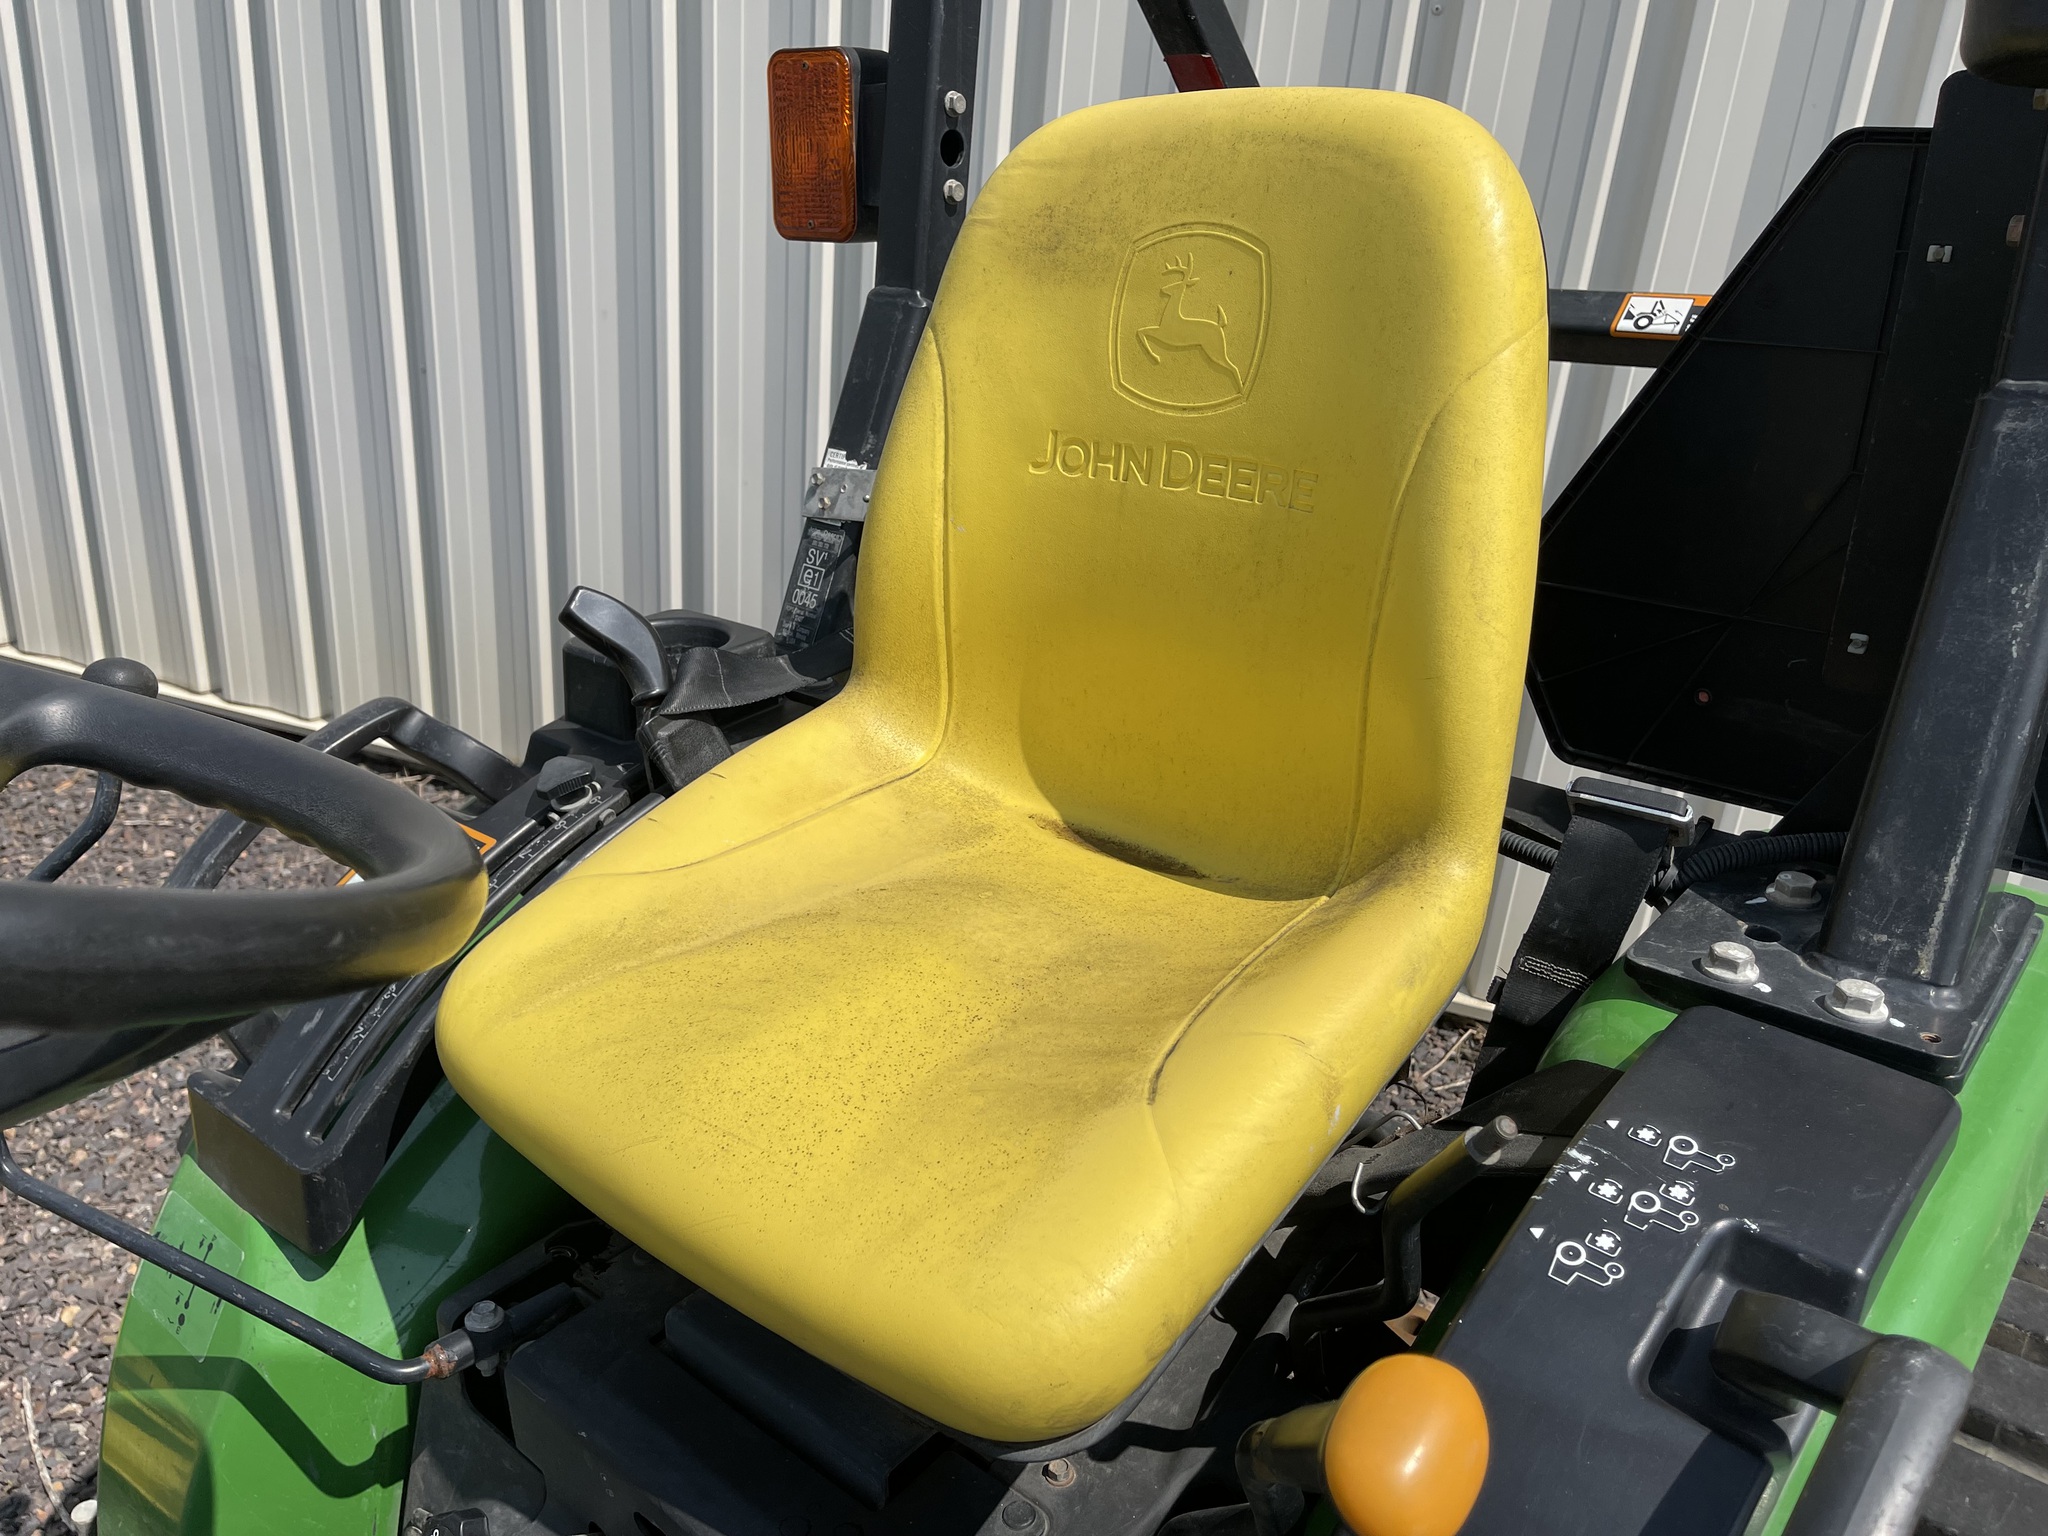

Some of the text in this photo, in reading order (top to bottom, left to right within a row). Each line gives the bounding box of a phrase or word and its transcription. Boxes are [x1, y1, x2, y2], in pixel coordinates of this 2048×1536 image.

[1028, 429, 1319, 514] JOHN DEERE
[792, 588, 818, 609] 0045
